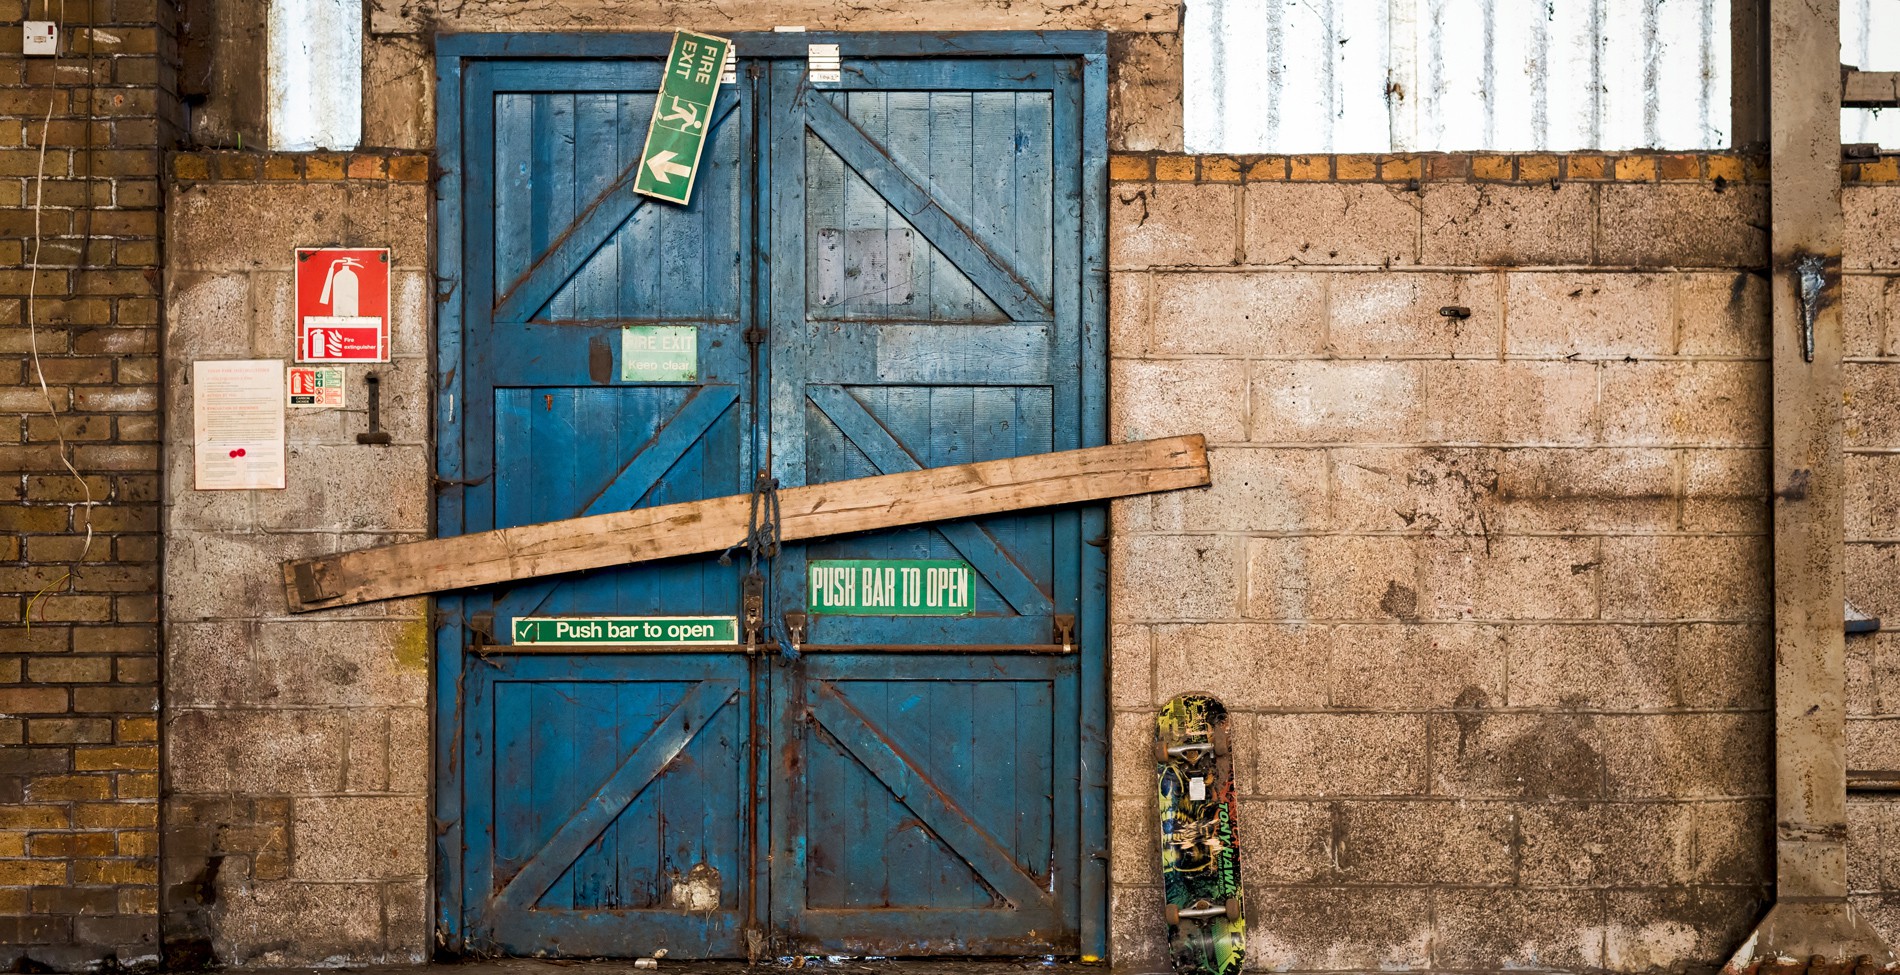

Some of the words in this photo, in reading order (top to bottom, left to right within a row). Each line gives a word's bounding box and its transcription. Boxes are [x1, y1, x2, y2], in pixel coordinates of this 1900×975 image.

[676, 40, 698, 80] EXIT
[695, 45, 718, 85] FIRE
[662, 335, 694, 350] EXIT
[628, 360, 658, 371] Keep
[662, 360, 690, 371] clear
[812, 567, 856, 607] PUSH
[861, 567, 895, 607] BAR
[900, 567, 920, 607] TO
[926, 567, 969, 607] OPEN
[556, 621, 602, 638] Push
[607, 622, 639, 638] bar
[643, 622, 662, 638] to
[667, 624, 714, 641] open
[1218, 802, 1232, 846] TONY
[1222, 846, 1237, 896] HAWK
